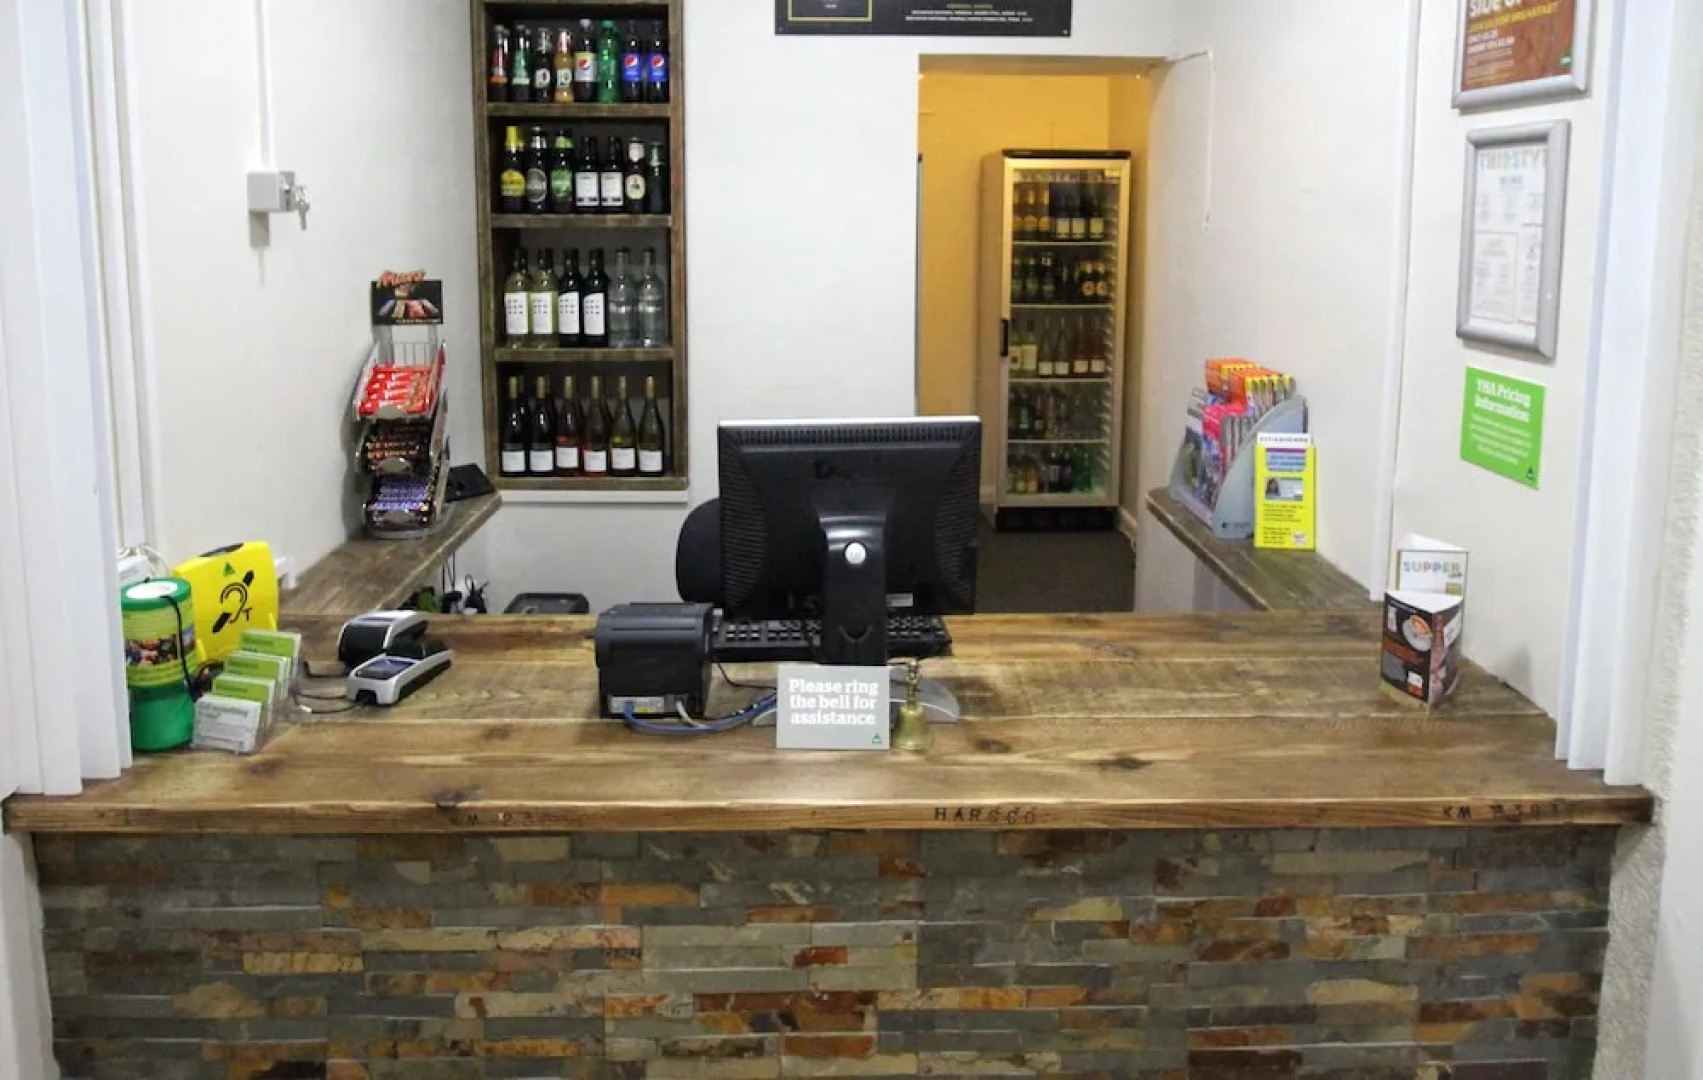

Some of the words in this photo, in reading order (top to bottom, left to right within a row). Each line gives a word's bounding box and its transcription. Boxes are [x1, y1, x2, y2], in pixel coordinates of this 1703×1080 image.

[1403, 560, 1462, 574] SUPPER
[789, 678, 842, 694] Please
[845, 679, 879, 696] ring
[790, 695, 817, 709] the
[819, 695, 850, 709] bell
[852, 695, 877, 709] for
[791, 710, 876, 725] assistance
